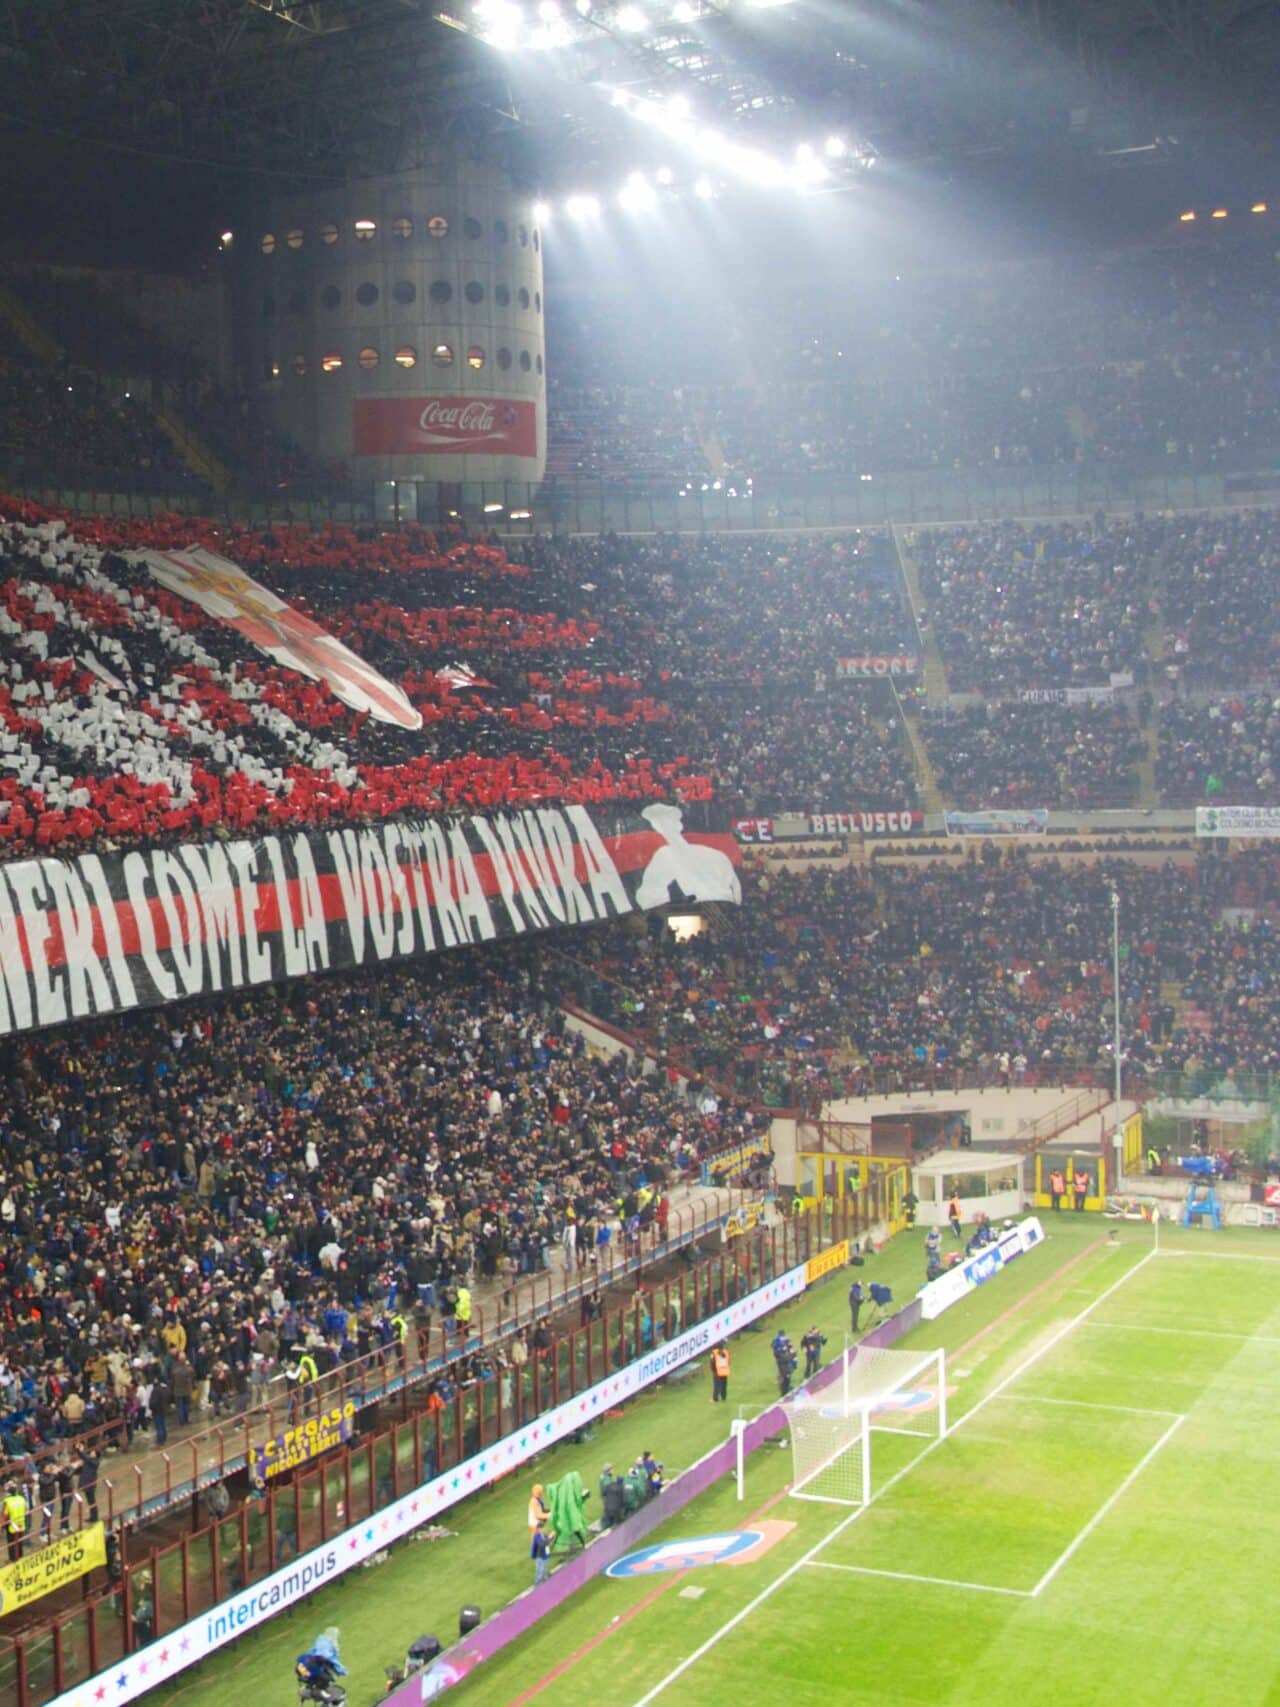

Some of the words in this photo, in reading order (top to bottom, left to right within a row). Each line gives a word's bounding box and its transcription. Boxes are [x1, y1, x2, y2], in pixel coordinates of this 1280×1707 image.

[812, 812, 912, 834] BELLUSCO
[124, 840, 271, 1000] COME
[263, 831, 330, 977] LA
[326, 814, 496, 964] VOSTRA
[639, 1329, 709, 1382] intercampus
[15, 1574, 41, 1591] Bar
[45, 1549, 84, 1577] DINO
[207, 1551, 336, 1643] intercampus
